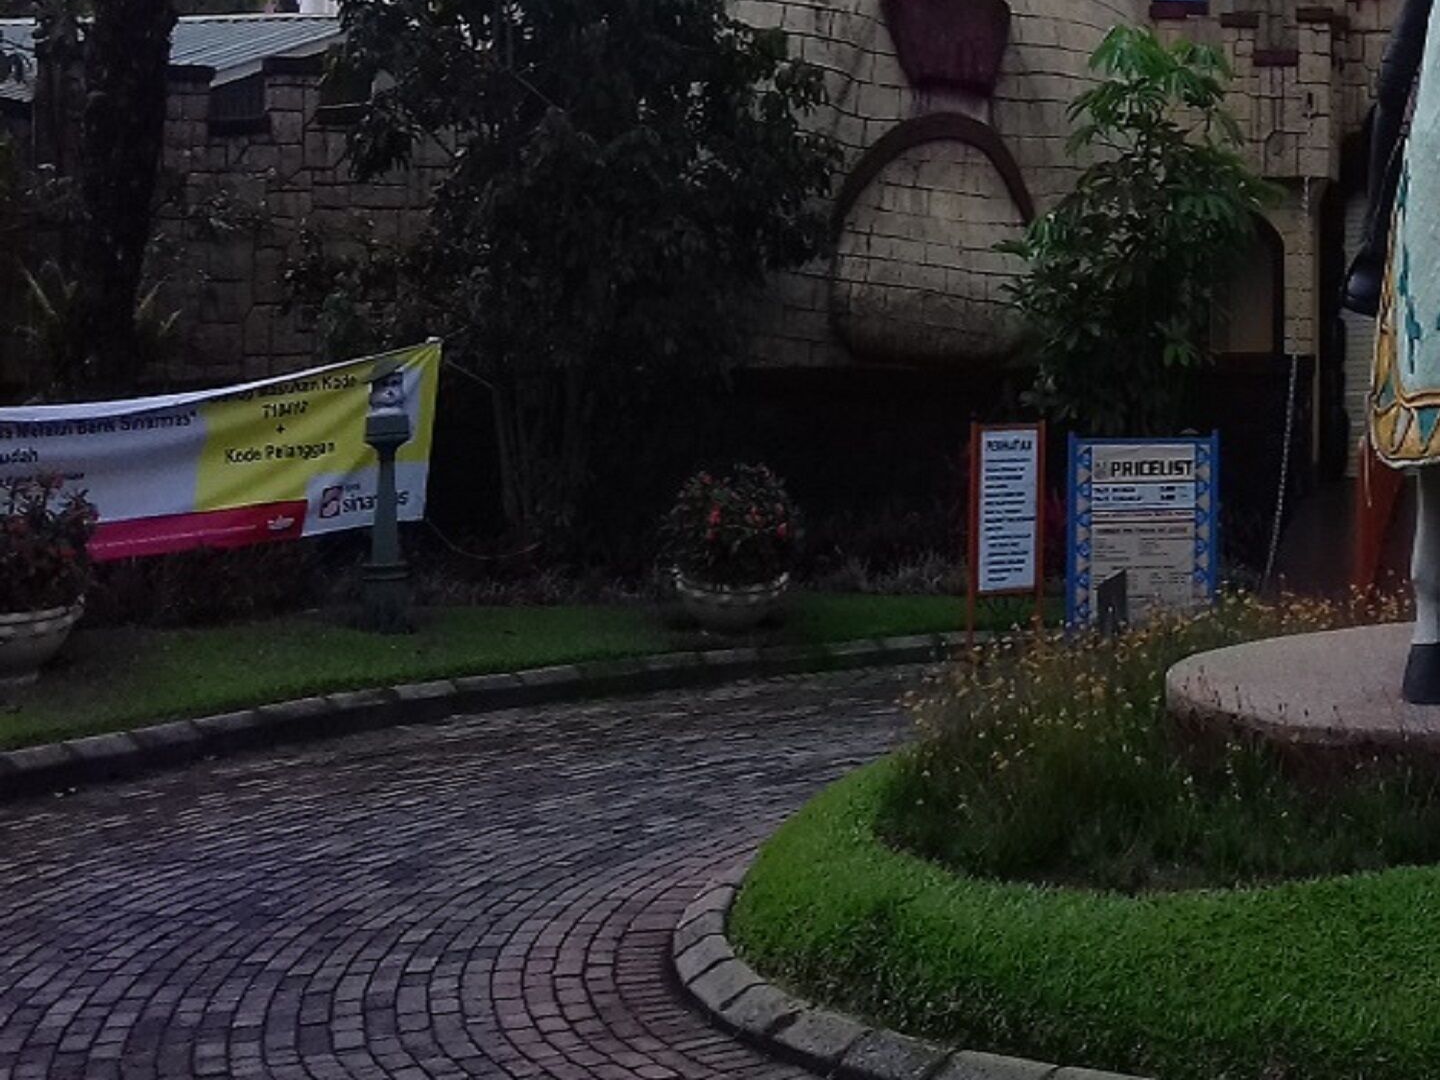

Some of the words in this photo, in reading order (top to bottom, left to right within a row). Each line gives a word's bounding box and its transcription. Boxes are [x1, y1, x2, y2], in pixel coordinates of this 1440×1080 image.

[225, 448, 261, 463] Kode
[265, 441, 335, 461] Pelanggan
[1111, 460, 1193, 477] PRICELIST
